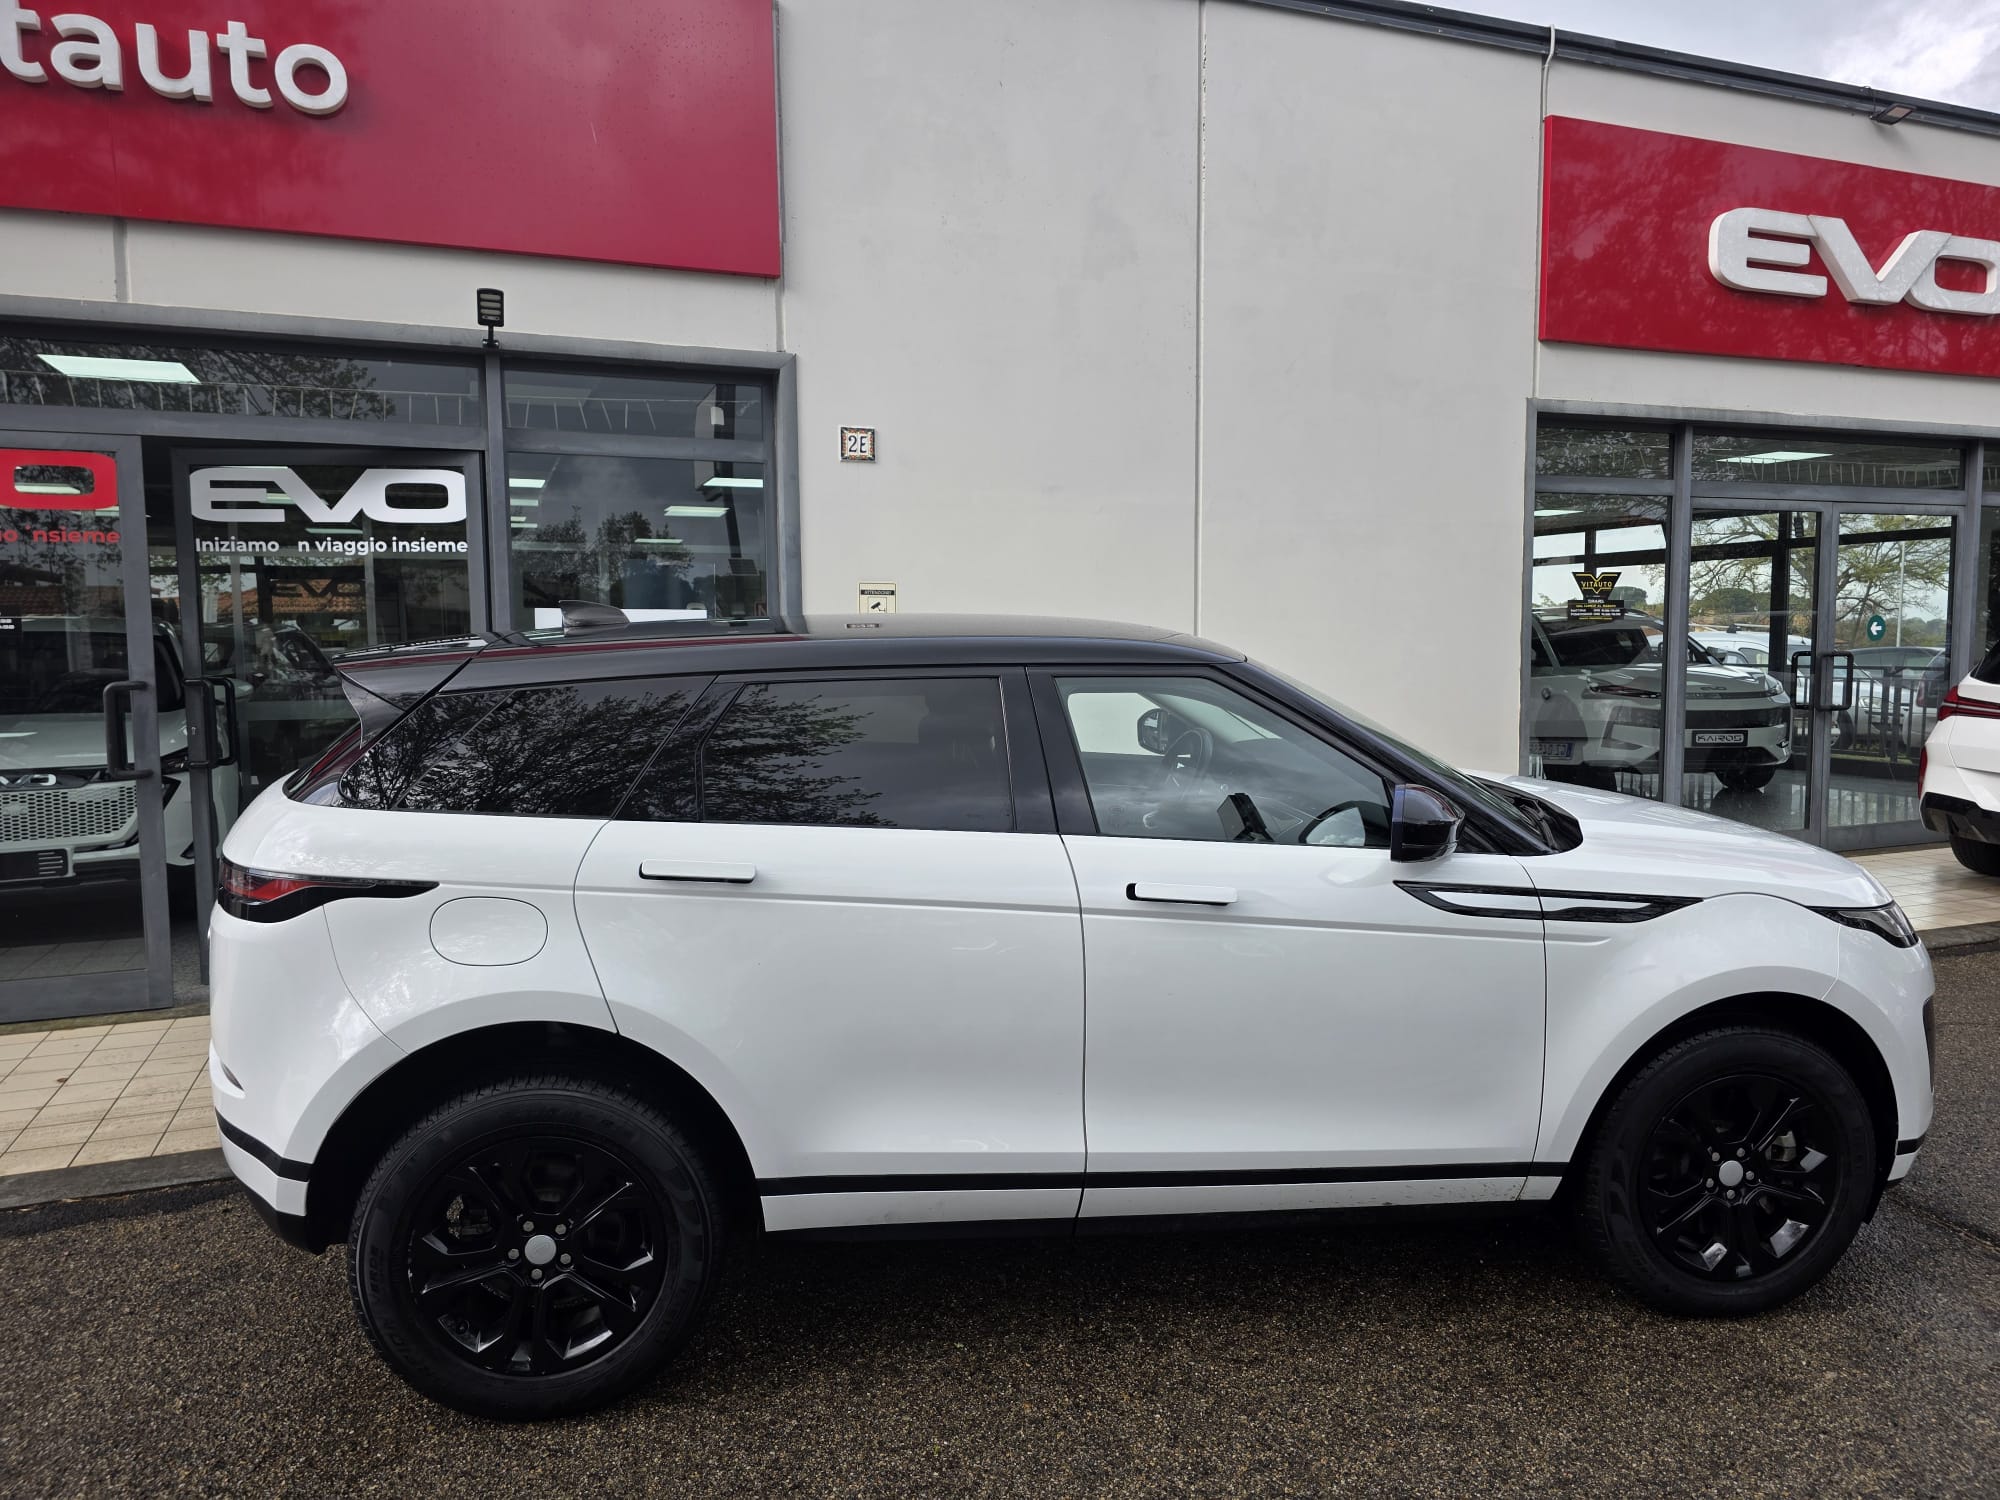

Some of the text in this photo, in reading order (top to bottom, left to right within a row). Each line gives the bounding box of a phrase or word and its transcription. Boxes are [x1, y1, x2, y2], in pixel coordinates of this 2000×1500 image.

[0, 0, 348, 115] tauto
[1708, 207, 2000, 316] EVO
[848, 435, 868, 453] 2E
[189, 467, 467, 523] EVO
[195, 536, 279, 553] Iniziamo
[315, 536, 387, 556] viaggio
[392, 536, 468, 553] insieme
